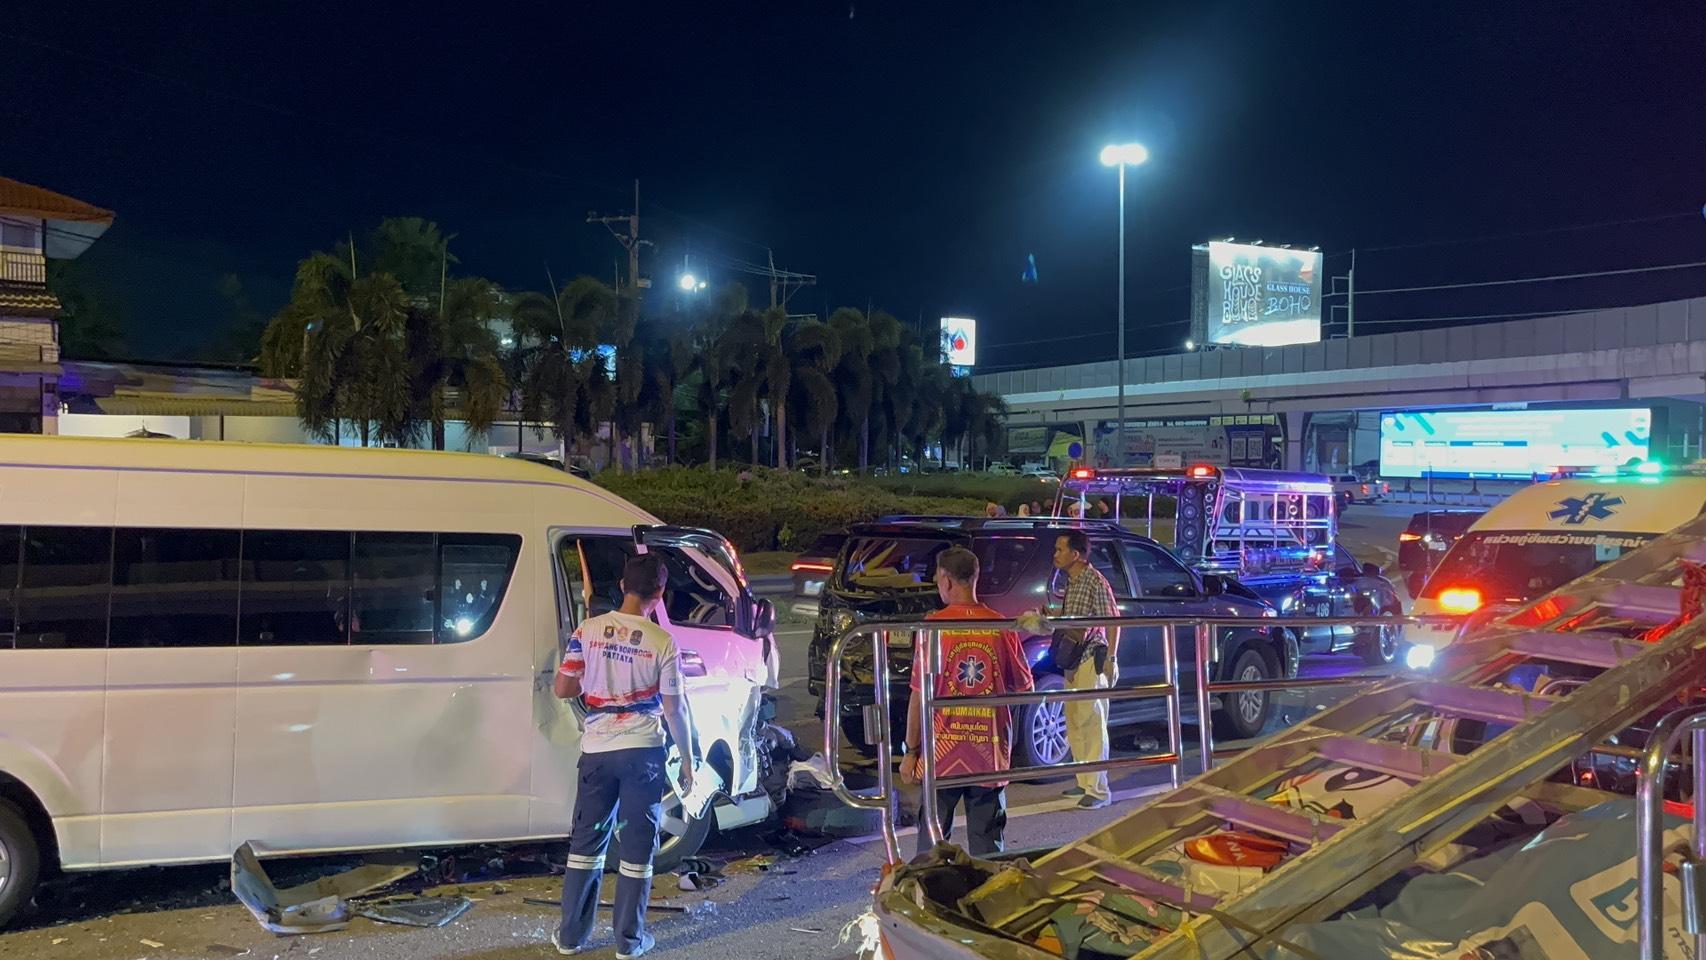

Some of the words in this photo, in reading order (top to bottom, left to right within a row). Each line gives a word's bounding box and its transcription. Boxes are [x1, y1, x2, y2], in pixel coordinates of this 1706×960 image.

[1220, 264, 1261, 284] GLASS
[1224, 280, 1262, 300] HOUSE
[1266, 283, 1288, 292] GLASS
[1288, 285, 1311, 295] HOUSE
[1264, 295, 1311, 315] BOHO
[603, 651, 633, 663] PATTAYA
